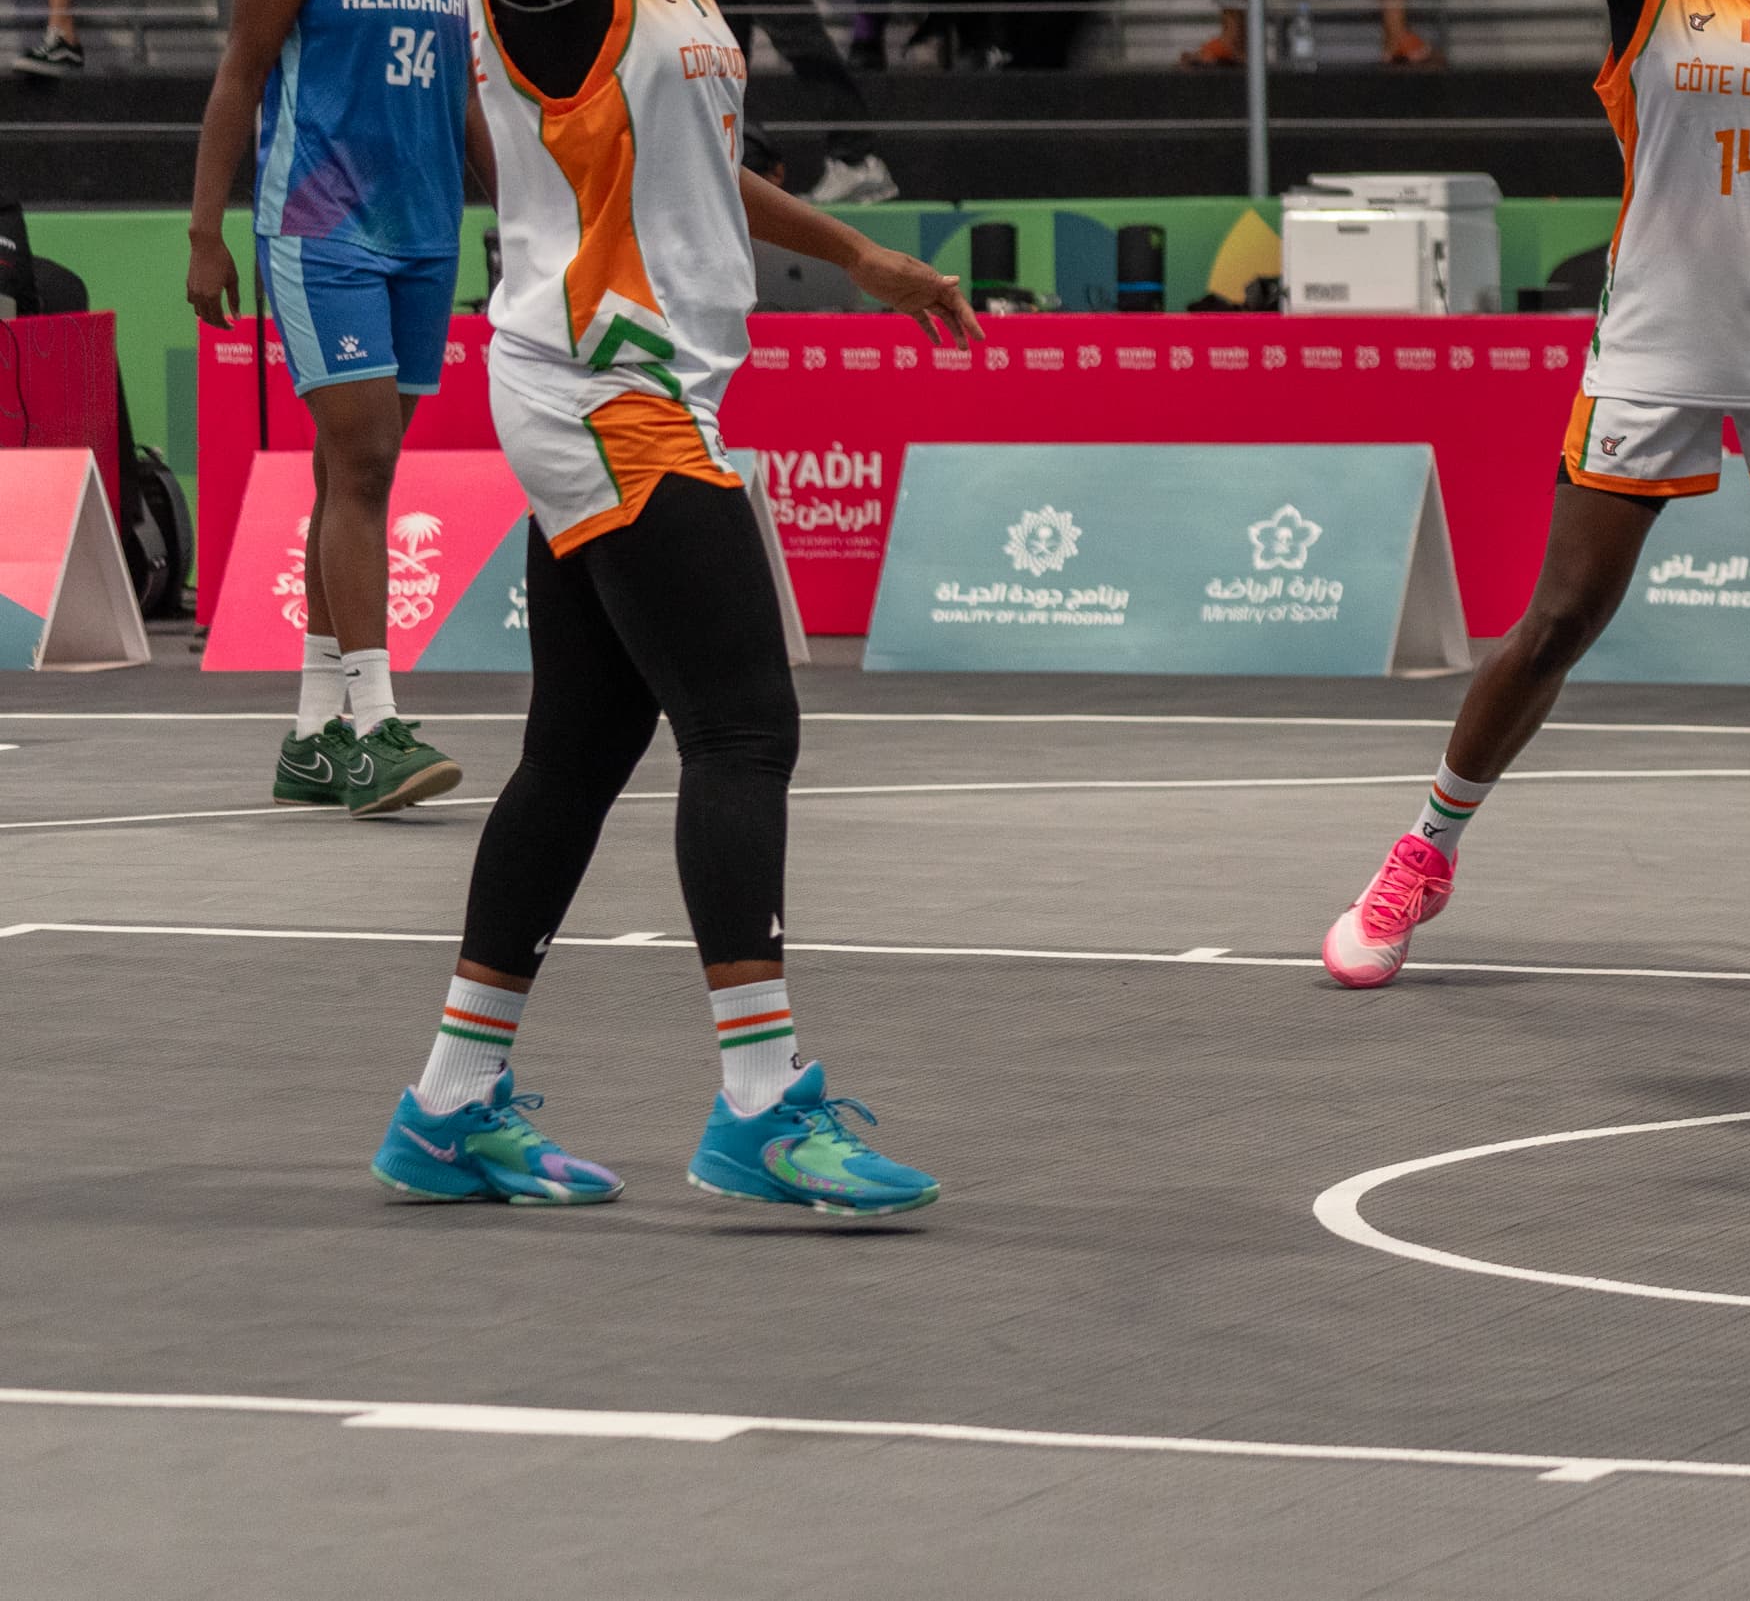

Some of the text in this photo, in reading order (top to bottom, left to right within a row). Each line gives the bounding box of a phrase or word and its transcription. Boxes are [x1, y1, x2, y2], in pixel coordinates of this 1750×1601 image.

[385, 26, 436, 89] 34
[1675, 57, 1734, 96] CÔTE
[760, 441, 882, 496] IYADH
[388, 573, 441, 597] audi
[1647, 586, 1716, 607] RIYADH
[931, 608, 993, 624] QUALITY
[1201, 603, 1266, 625] Ministry
[1289, 602, 1339, 624] Sport
